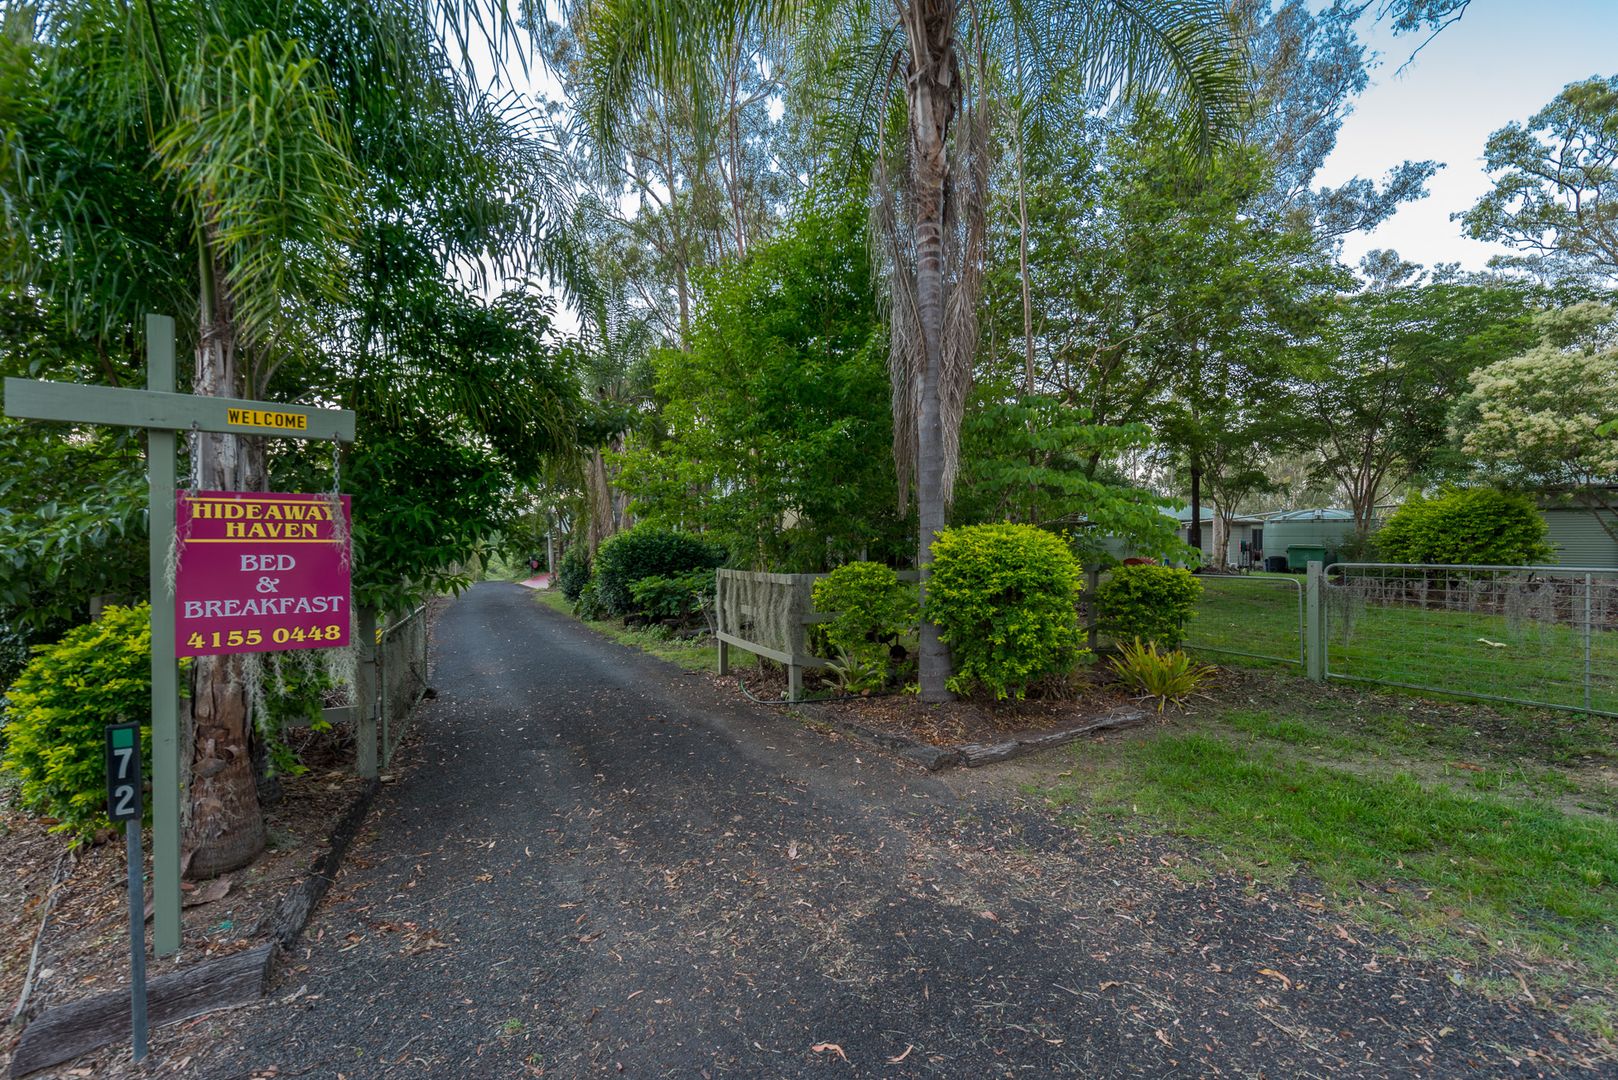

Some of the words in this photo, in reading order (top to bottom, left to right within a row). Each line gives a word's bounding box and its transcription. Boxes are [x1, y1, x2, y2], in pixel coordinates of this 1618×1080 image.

[228, 410, 305, 428] WELCOME
[192, 503, 334, 521] HIDEAWAY
[225, 522, 318, 538] HAVEN
[240, 554, 296, 571] BED
[256, 576, 280, 593] &
[184, 596, 344, 618] BREAKFAST
[187, 629, 263, 649] 4155
[272, 625, 341, 644] 0448
[113, 747, 135, 816] 72
